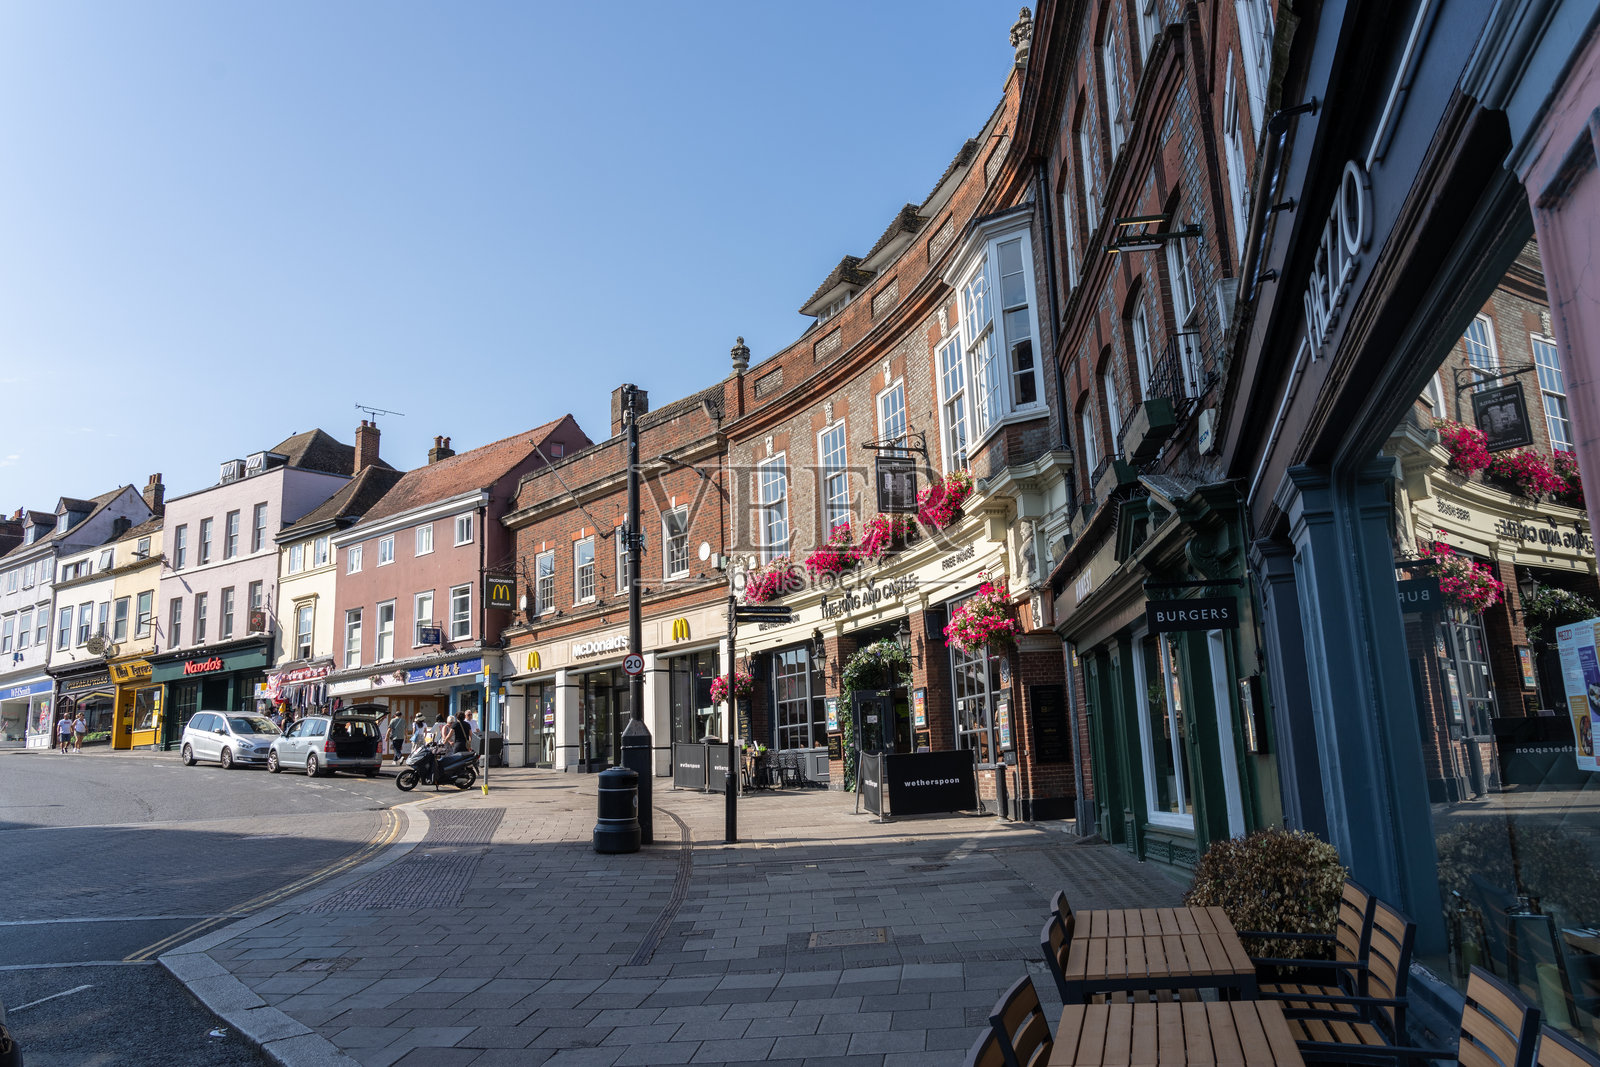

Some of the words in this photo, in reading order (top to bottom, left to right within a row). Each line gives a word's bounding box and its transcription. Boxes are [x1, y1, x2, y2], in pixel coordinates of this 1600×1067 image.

[1303, 159, 1365, 363] PREZZO
[820, 601, 837, 619] THE
[838, 595, 861, 612] KING
[862, 588, 881, 607] AND
[883, 573, 918, 600] CASTLE
[1156, 607, 1229, 622] BURGERS
[572, 634, 629, 656] McDonald's
[183, 656, 223, 675] Nando's
[625, 659, 642, 670] 20
[903, 777, 960, 787] wetherspoon
